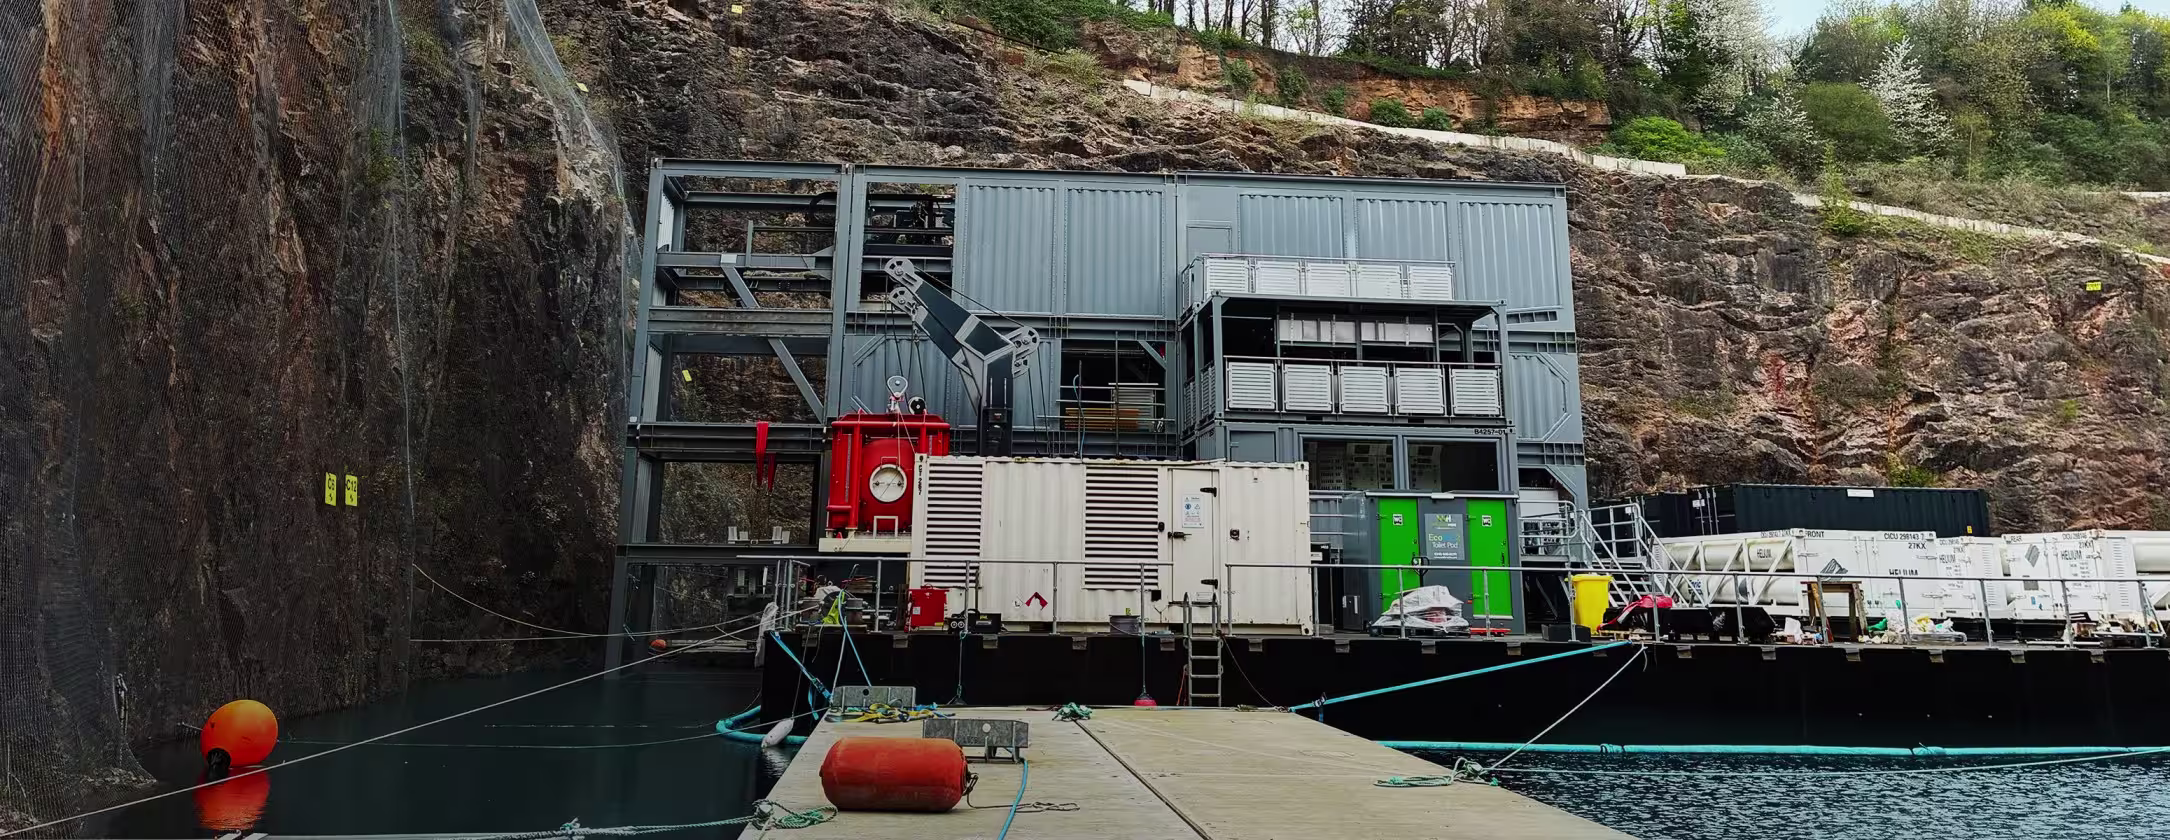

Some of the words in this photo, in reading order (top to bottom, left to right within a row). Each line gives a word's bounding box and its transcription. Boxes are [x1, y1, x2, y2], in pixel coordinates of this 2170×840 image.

[346, 479, 357, 492] C12
[1805, 530, 1825, 538] FRONT
[1908, 542, 1927, 550] 27KX
[2060, 550, 2083, 560] HELIUM
